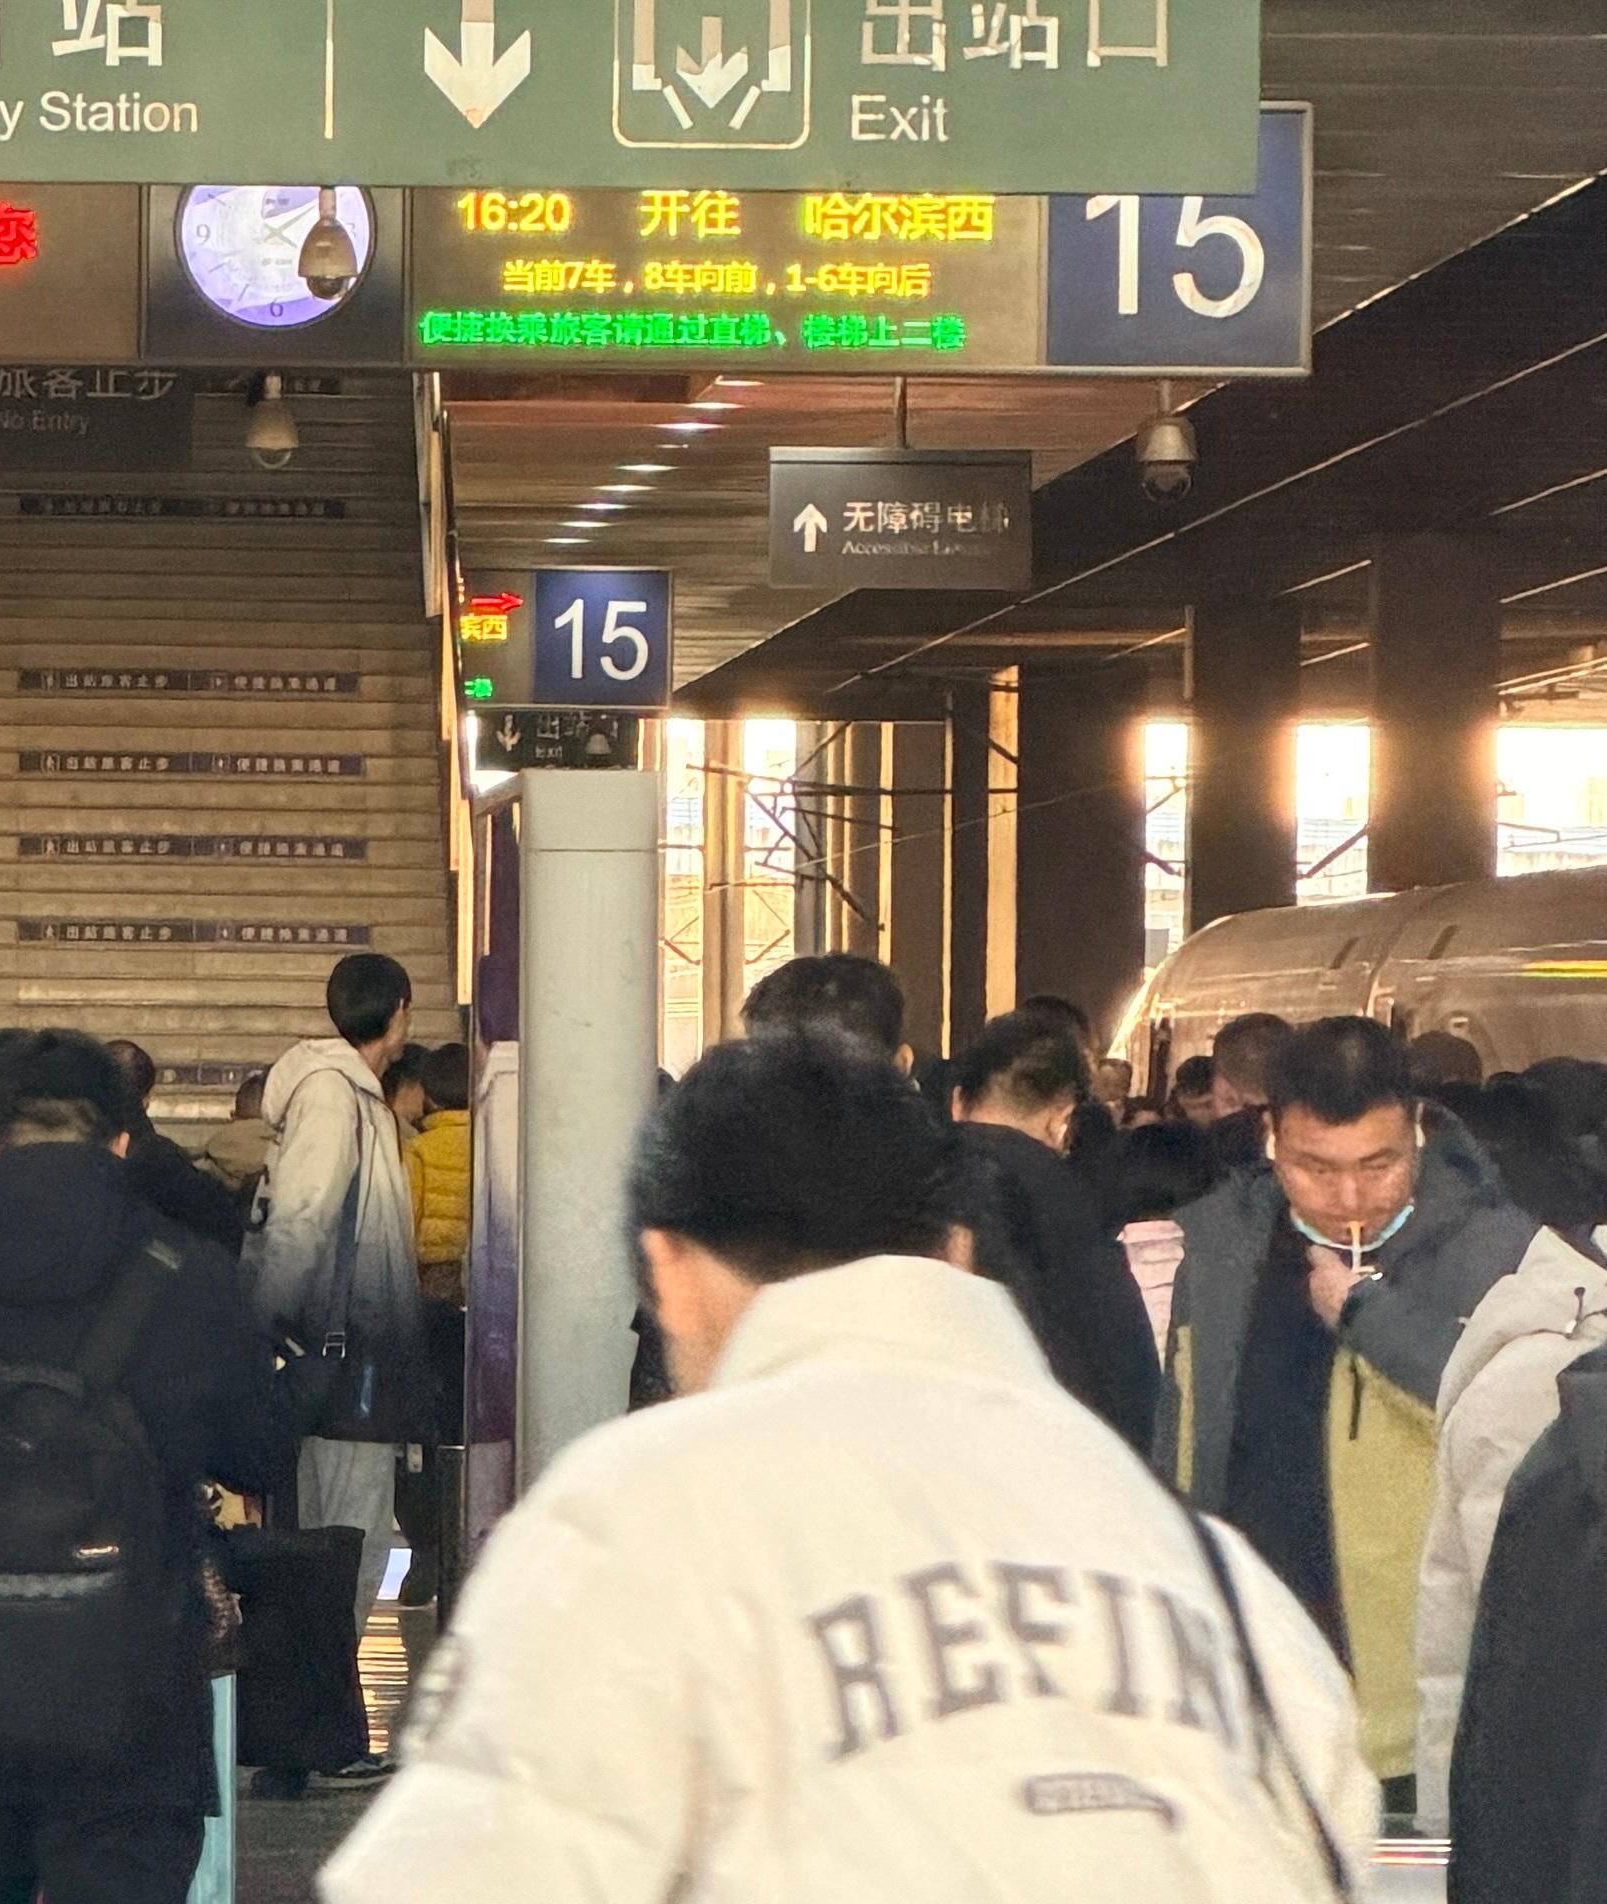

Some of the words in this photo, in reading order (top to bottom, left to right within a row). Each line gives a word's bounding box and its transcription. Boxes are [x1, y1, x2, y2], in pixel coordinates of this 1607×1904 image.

[39, 90, 199, 133] Station
[850, 94, 950, 144] Exit
[196, 223, 211, 246] 9
[459, 193, 571, 232] 16:20
[639, 189, 742, 238] 开往
[804, 192, 995, 241] 哈尔滨西
[1085, 194, 1265, 319] 15
[269, 299, 284, 318] 6
[33, 409, 90, 435] Entry
[554, 598, 649, 681] 15
